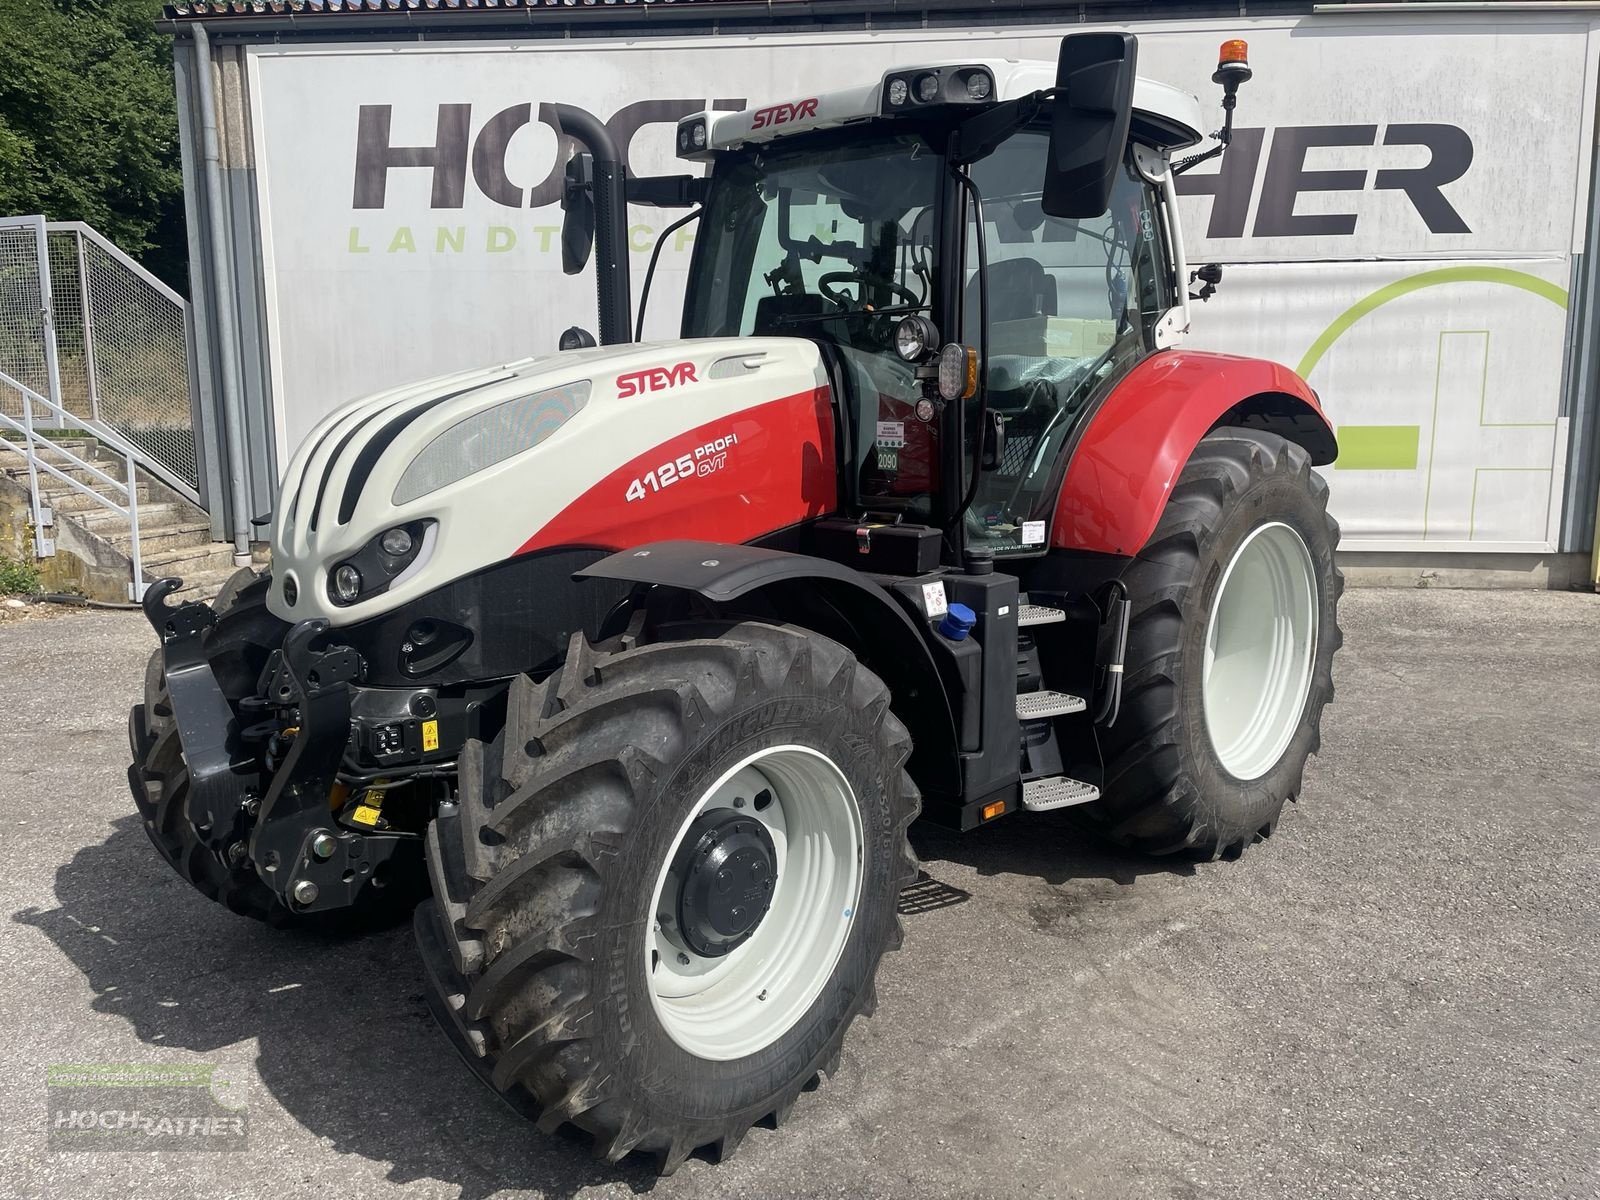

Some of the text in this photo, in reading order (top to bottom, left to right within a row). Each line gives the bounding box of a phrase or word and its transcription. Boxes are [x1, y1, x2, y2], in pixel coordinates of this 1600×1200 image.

[751, 98, 818, 130] STEYR
[615, 361, 699, 400] STEYR
[625, 432, 738, 503] 4125 PROFI
[696, 452, 728, 478] CVT
[878, 453, 897, 469] 2090
